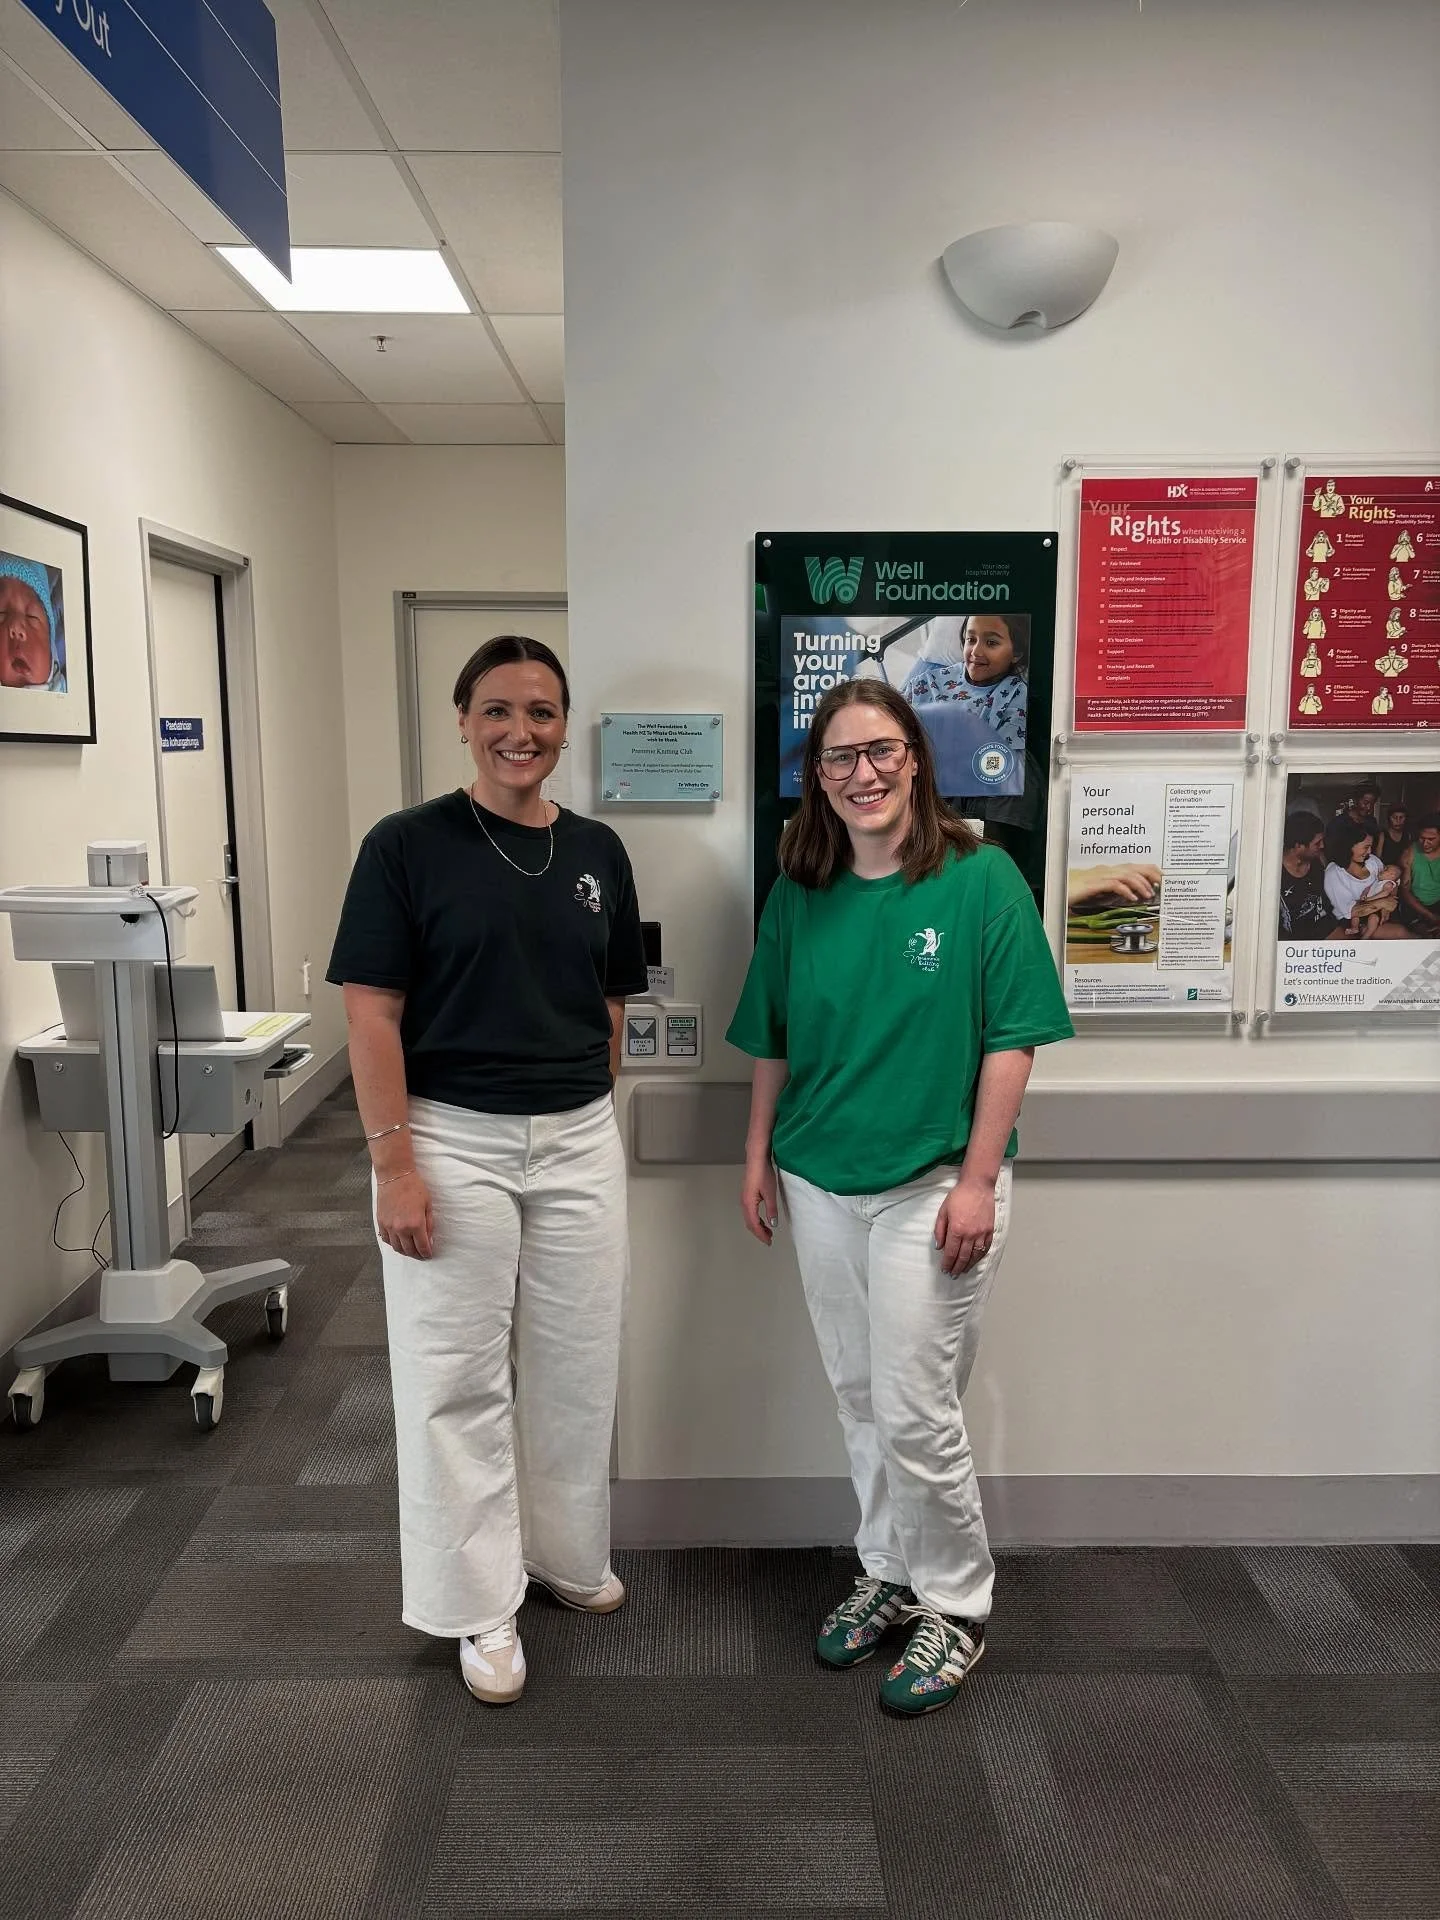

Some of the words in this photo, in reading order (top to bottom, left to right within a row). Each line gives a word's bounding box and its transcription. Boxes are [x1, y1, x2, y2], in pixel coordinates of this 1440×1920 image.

[1168, 484, 1188, 497] HDC
[1350, 495, 1374, 504] Your
[1089, 500, 1130, 515] Your
[1349, 506, 1396, 522] Rights
[1110, 515, 1180, 542] Rights
[1205, 527, 1239, 536] receiving
[1183, 537, 1218, 545] Disability
[1336, 534, 1342, 542] 1
[1417, 533, 1423, 542] 6
[875, 561, 924, 579] Well
[1334, 568, 1340, 576] 2
[1413, 570, 1420, 579] 7
[876, 581, 1009, 601] Foundation
[1331, 609, 1337, 618] 3
[1410, 609, 1416, 618] 8
[794, 632, 881, 653] Turning
[1401, 644, 1408, 652] 9
[1327, 649, 1334, 658] 4
[794, 654, 847, 673] your
[1325, 685, 1331, 694] 5
[1397, 685, 1410, 694] 10
[794, 691, 823, 709] int
[1083, 786, 1110, 797] Your
[1082, 805, 1134, 819] personal
[1081, 824, 1104, 835] and
[1108, 824, 1146, 835] health
[1080, 843, 1151, 854] information
[1286, 947, 1309, 958] Our
[1312, 947, 1356, 960] tūpuna
[1286, 962, 1342, 973] breastfed
[1299, 994, 1364, 1002] WHAKAWHETU
